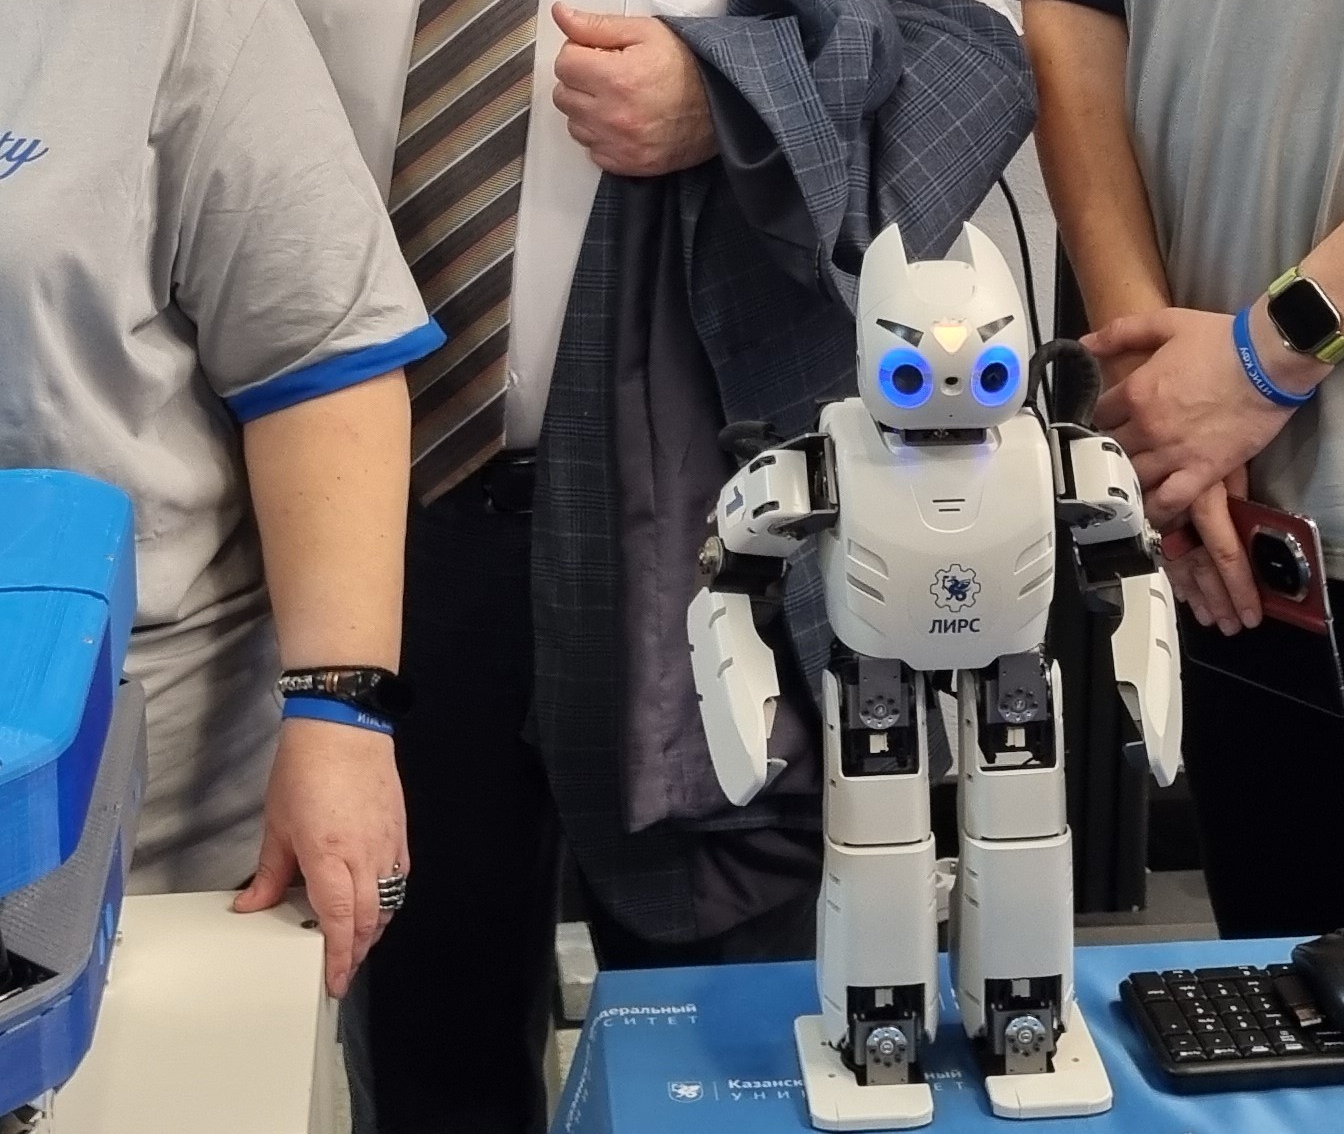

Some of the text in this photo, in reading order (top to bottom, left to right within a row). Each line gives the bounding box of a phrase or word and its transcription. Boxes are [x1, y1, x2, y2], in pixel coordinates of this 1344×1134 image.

[928, 618, 981, 634] ЛИРС
[596, 1003, 698, 1019] деральный
[603, 1015, 699, 1028] СИТЕТ
